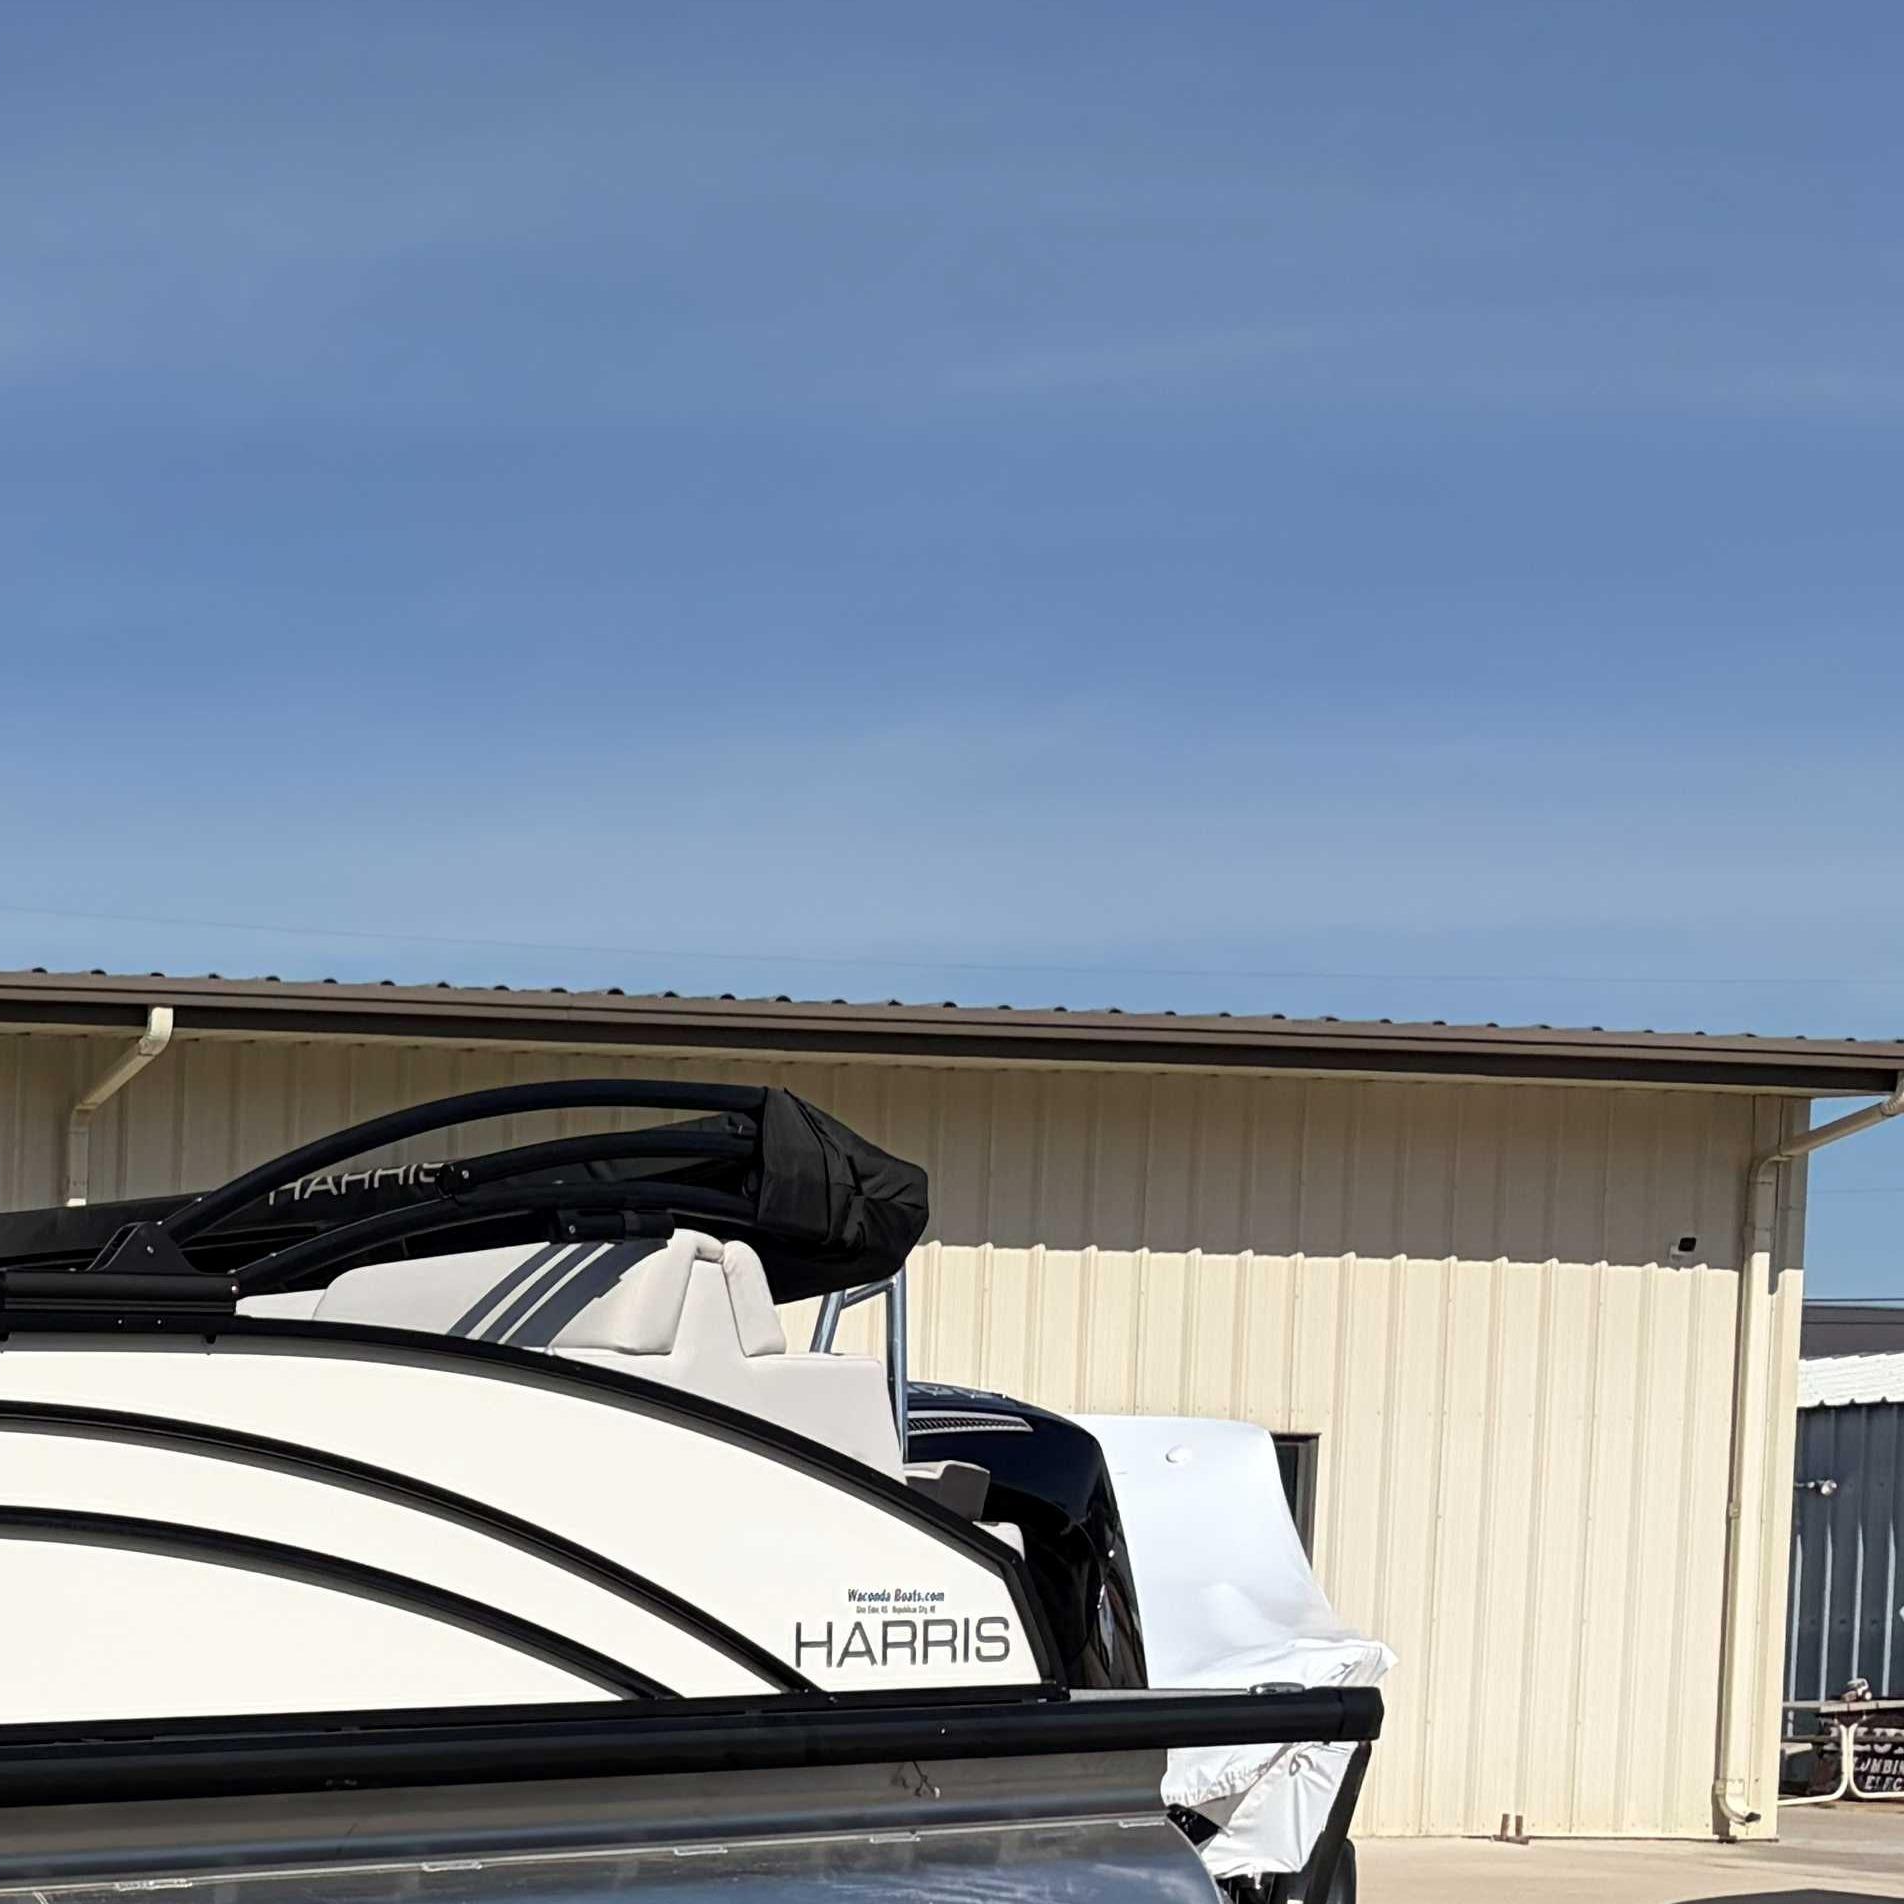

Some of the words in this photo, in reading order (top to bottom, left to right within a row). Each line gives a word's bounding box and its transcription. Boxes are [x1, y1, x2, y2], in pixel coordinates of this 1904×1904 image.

[848, 1588, 891, 1602] Waconda
[894, 1588, 945, 1602] Boats.com
[795, 1616, 1010, 1668] HARRIS
